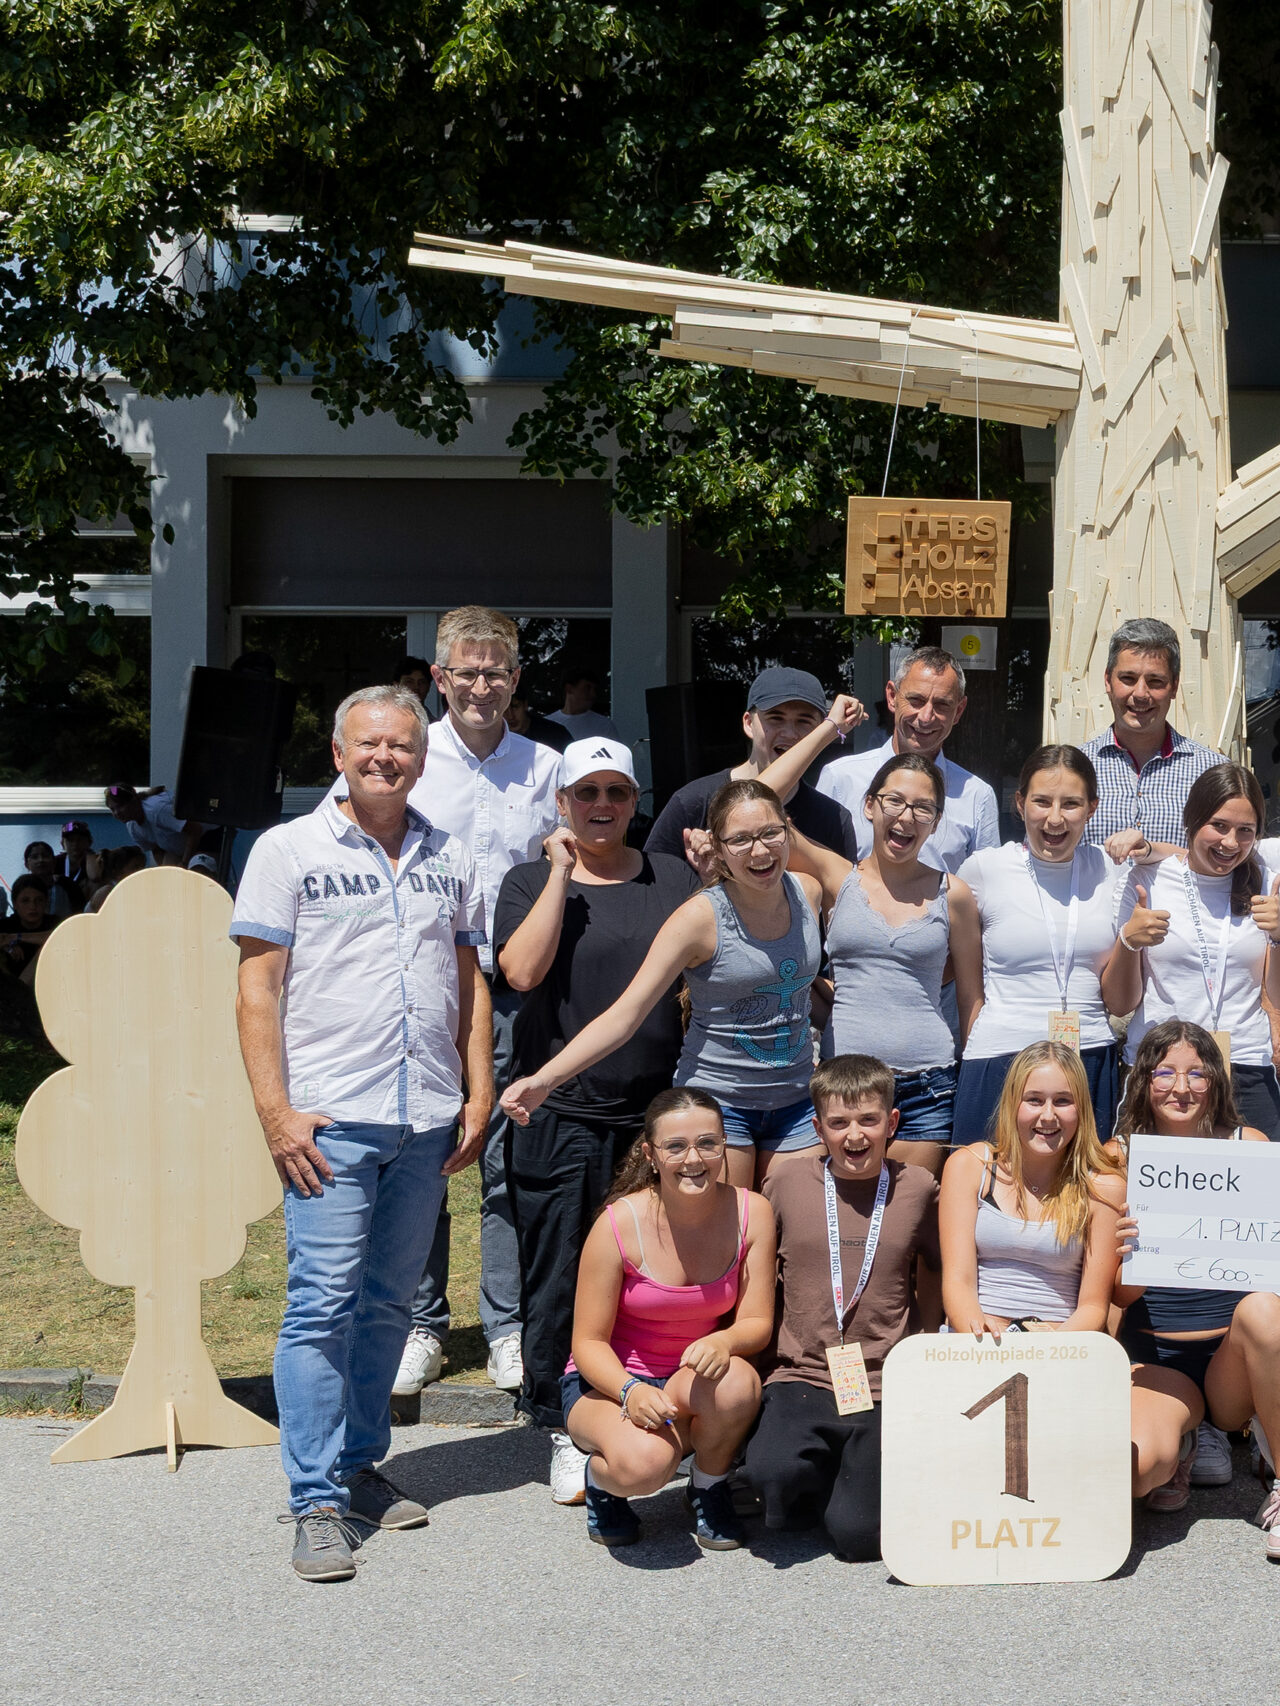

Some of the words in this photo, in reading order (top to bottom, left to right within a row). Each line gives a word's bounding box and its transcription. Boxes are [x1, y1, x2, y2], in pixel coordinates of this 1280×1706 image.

[903, 514, 997, 541] TFBS
[903, 543, 996, 570] HOLZ
[902, 573, 994, 600] Absam
[967, 640, 974, 650] 5
[303, 873, 381, 901] CAMP
[1183, 871, 1192, 887] WIR
[1187, 888, 1200, 926] SCHAUEN
[1196, 928, 1206, 944] AUF
[1138, 1164, 1241, 1192] Scheck
[826, 1184, 837, 1228] SCHAUEN
[1136, 1203, 1149, 1212] Für
[829, 1229, 839, 1248] AUF
[1177, 1217, 1208, 1240] 1.
[859, 1268, 869, 1287] WIR
[865, 1223, 880, 1268] SCHAUEN
[873, 1203, 882, 1223] AUF
[1133, 1244, 1160, 1255] Betrag
[924, 1347, 1045, 1365] Holzolympiade
[1049, 1345, 1089, 1361] 2026
[960, 1371, 1035, 1503] 1
[951, 1517, 1062, 1550] PLATZ
